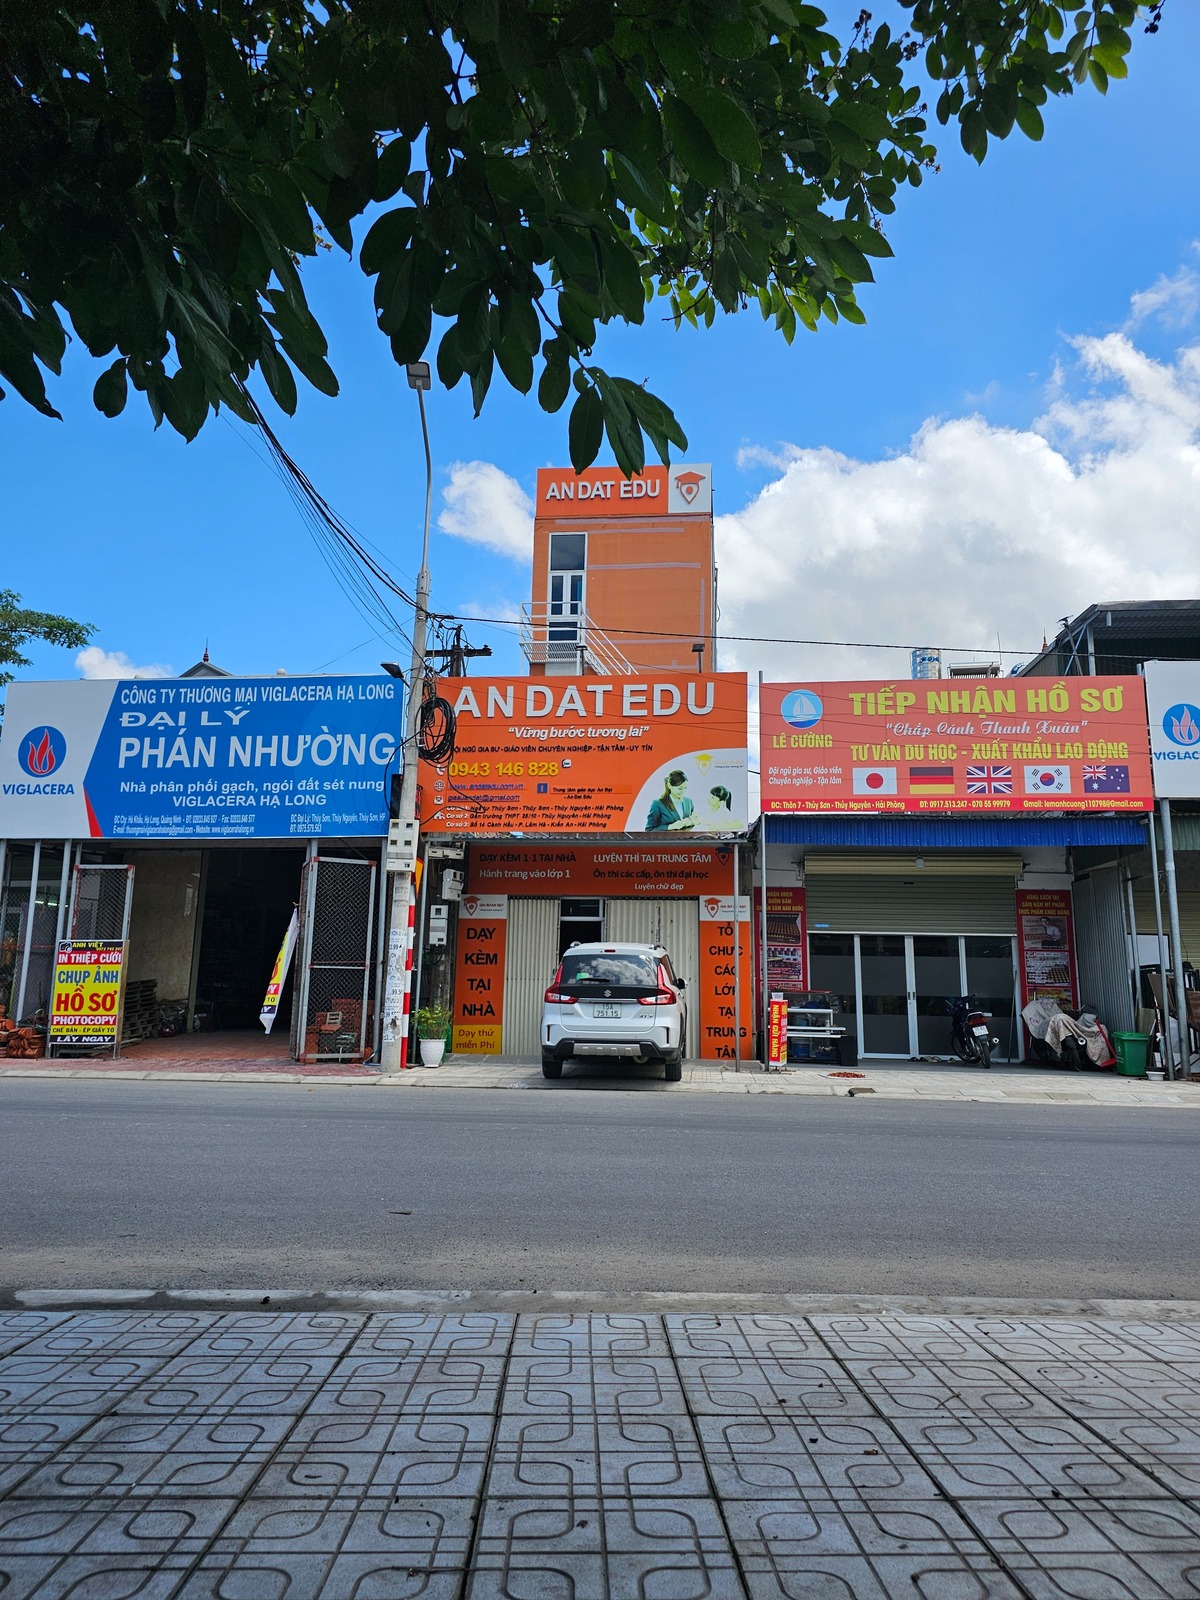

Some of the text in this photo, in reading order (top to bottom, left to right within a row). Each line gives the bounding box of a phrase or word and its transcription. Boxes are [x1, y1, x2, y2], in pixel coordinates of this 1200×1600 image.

[545, 478, 660, 501] AN DAT EDU
[121, 683, 395, 706] CÔNG TY THƯƠNG MẠI VIGLACERA HẠ LONG
[454, 681, 715, 719] AN DAT EDU
[848, 681, 1124, 719] TIẾP NHẬN HỒ SƠ
[119, 705, 251, 730] ĐẠI LÝ
[549, 726, 586, 739] bước
[587, 727, 628, 741] tương
[980, 721, 1031, 735] Thanh
[118, 725, 396, 768] PHÁN NHƯỜNG
[772, 731, 833, 748] LÊ CƯỜNG
[504, 744, 520, 753] GIÁO
[521, 745, 537, 753] VIÊN
[538, 744, 566, 753] CHUYÊN
[567, 744, 593, 753] NGHIỆP
[597, 744, 610, 753] TẬN
[611, 744, 626, 752] TÂM
[641, 743, 653, 752] TÍN
[851, 736, 1129, 763] TƯ VẤN DU HỌC XUẤT KHẨU LAO ĐỘNG
[1153, 750, 1200, 761] VIGLAC
[448, 761, 559, 777] 0943 146 828
[792, 767, 803, 776] gia
[3, 784, 75, 796] VIGLACERA
[120, 777, 385, 795] Nhà phân phối gạch, ngói đất sét nung
[173, 794, 327, 809] VIGLACERA HẠ LONG
[771, 801, 782, 809] ĐC:
[783, 801, 797, 809] Thôn
[919, 800, 1011, 808] ĐT: 0917.513.247 070 55 99979
[480, 851, 577, 864] DẠY KÈM 1-1 TẠI NHÀ
[593, 852, 622, 865] LUYỆN
[640, 854, 655, 864] TẠI
[657, 854, 689, 863] TRUNG
[690, 852, 712, 863] TÂM
[480, 868, 571, 881] Hành trang vào lớp 1
[593, 868, 709, 880] Ôn thi các cấp, ôn thi đại học
[634, 883, 655, 891] Luyện
[670, 883, 684, 891] đẹp
[466, 927, 497, 943] DẠY
[717, 922, 734, 936] TỔ
[58, 951, 122, 965] IN THIỆP CƯỚI
[464, 949, 498, 965] KÈM
[58, 965, 119, 986] CHỤP ẢNH
[467, 978, 491, 994] TẠI
[56, 984, 118, 1012] HỒ SƠ
[462, 1000, 496, 1017] NHÀ
[718, 1006, 736, 1019] TẠI
[53, 1015, 116, 1025] PHOTOCOPY
[56, 1034, 79, 1042] LẤY
[458, 1029, 476, 1040] Dạy
[456, 1039, 495, 1049] miễn Phí
